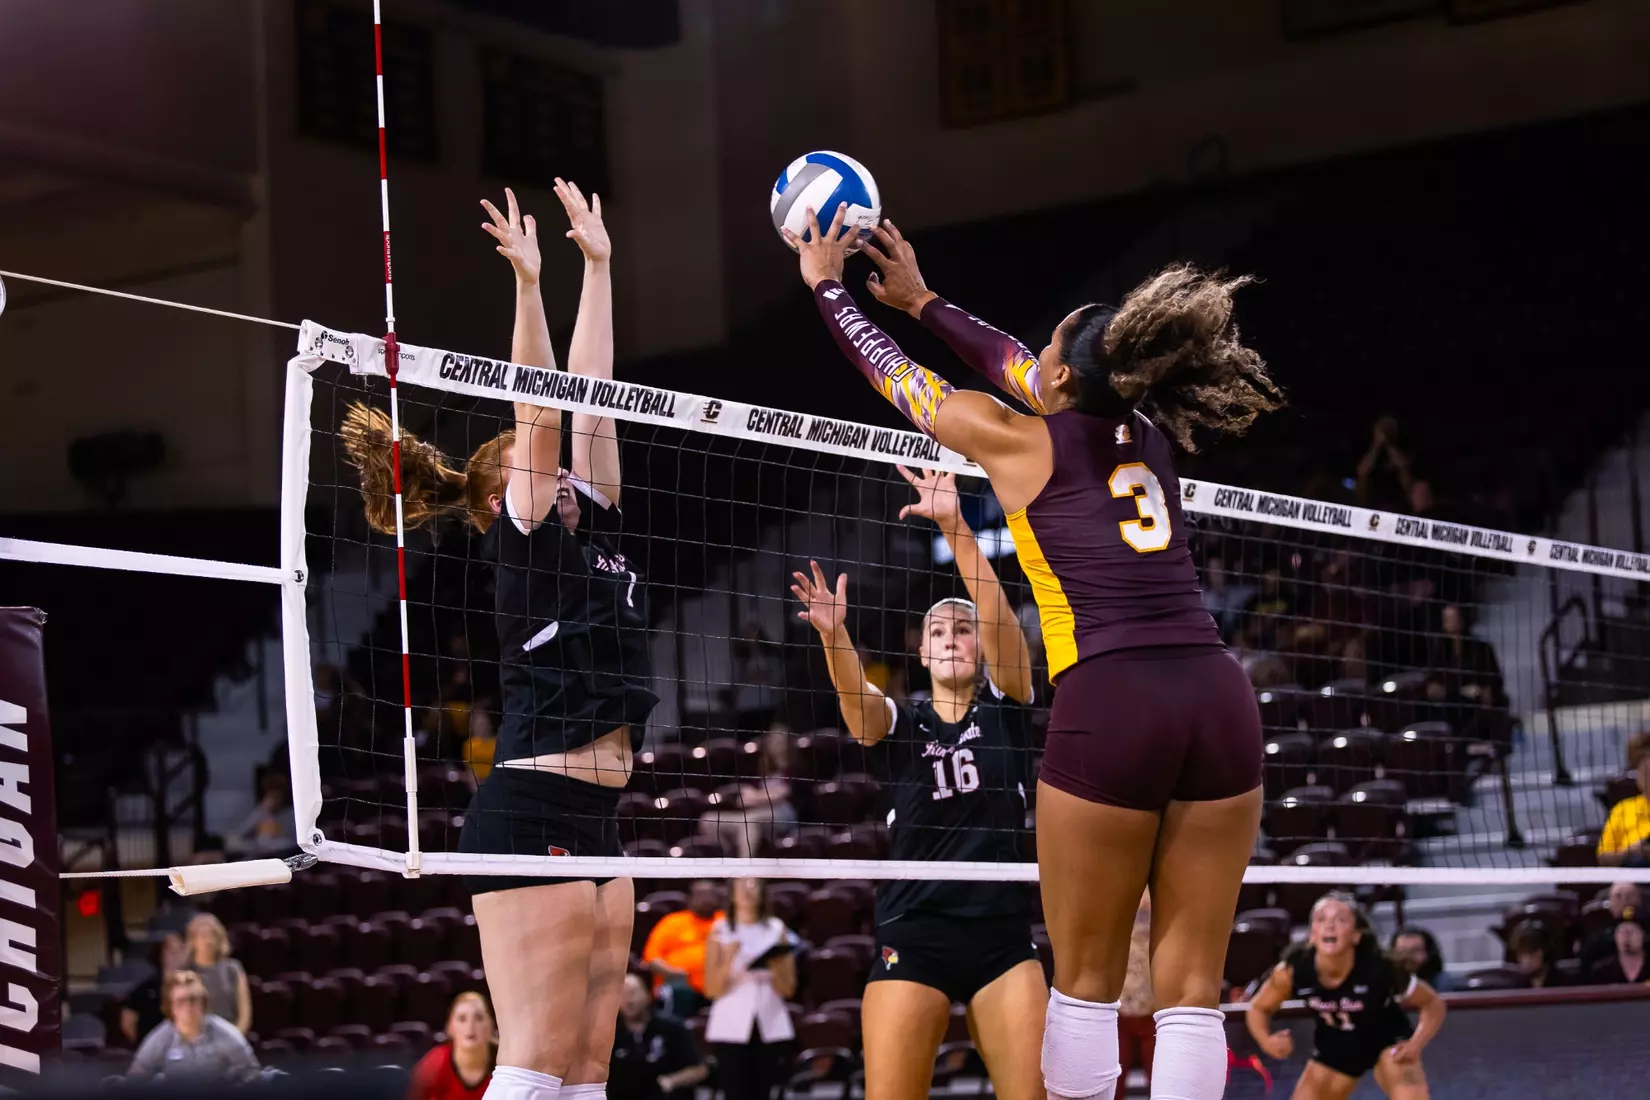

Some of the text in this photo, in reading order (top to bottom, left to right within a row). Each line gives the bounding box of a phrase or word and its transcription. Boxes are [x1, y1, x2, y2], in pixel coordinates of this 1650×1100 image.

[328, 334, 349, 346] Senoh
[835, 306, 917, 382] CHIPPEWAS
[439, 353, 675, 418] CENTRAL MICHIGAN VOLLEYBALL
[747, 408, 941, 462] CENTRAL MICHIGAN VOLLEYBALL
[1108, 462, 1172, 553] 3
[1214, 488, 1352, 527] CENTRAL MICHIGAN VOLLEYBALL
[1395, 517, 1513, 552] CENTRAL MICHIGAN VOLLEYBALL
[627, 571, 637, 608] 7
[932, 748, 980, 800] 16
